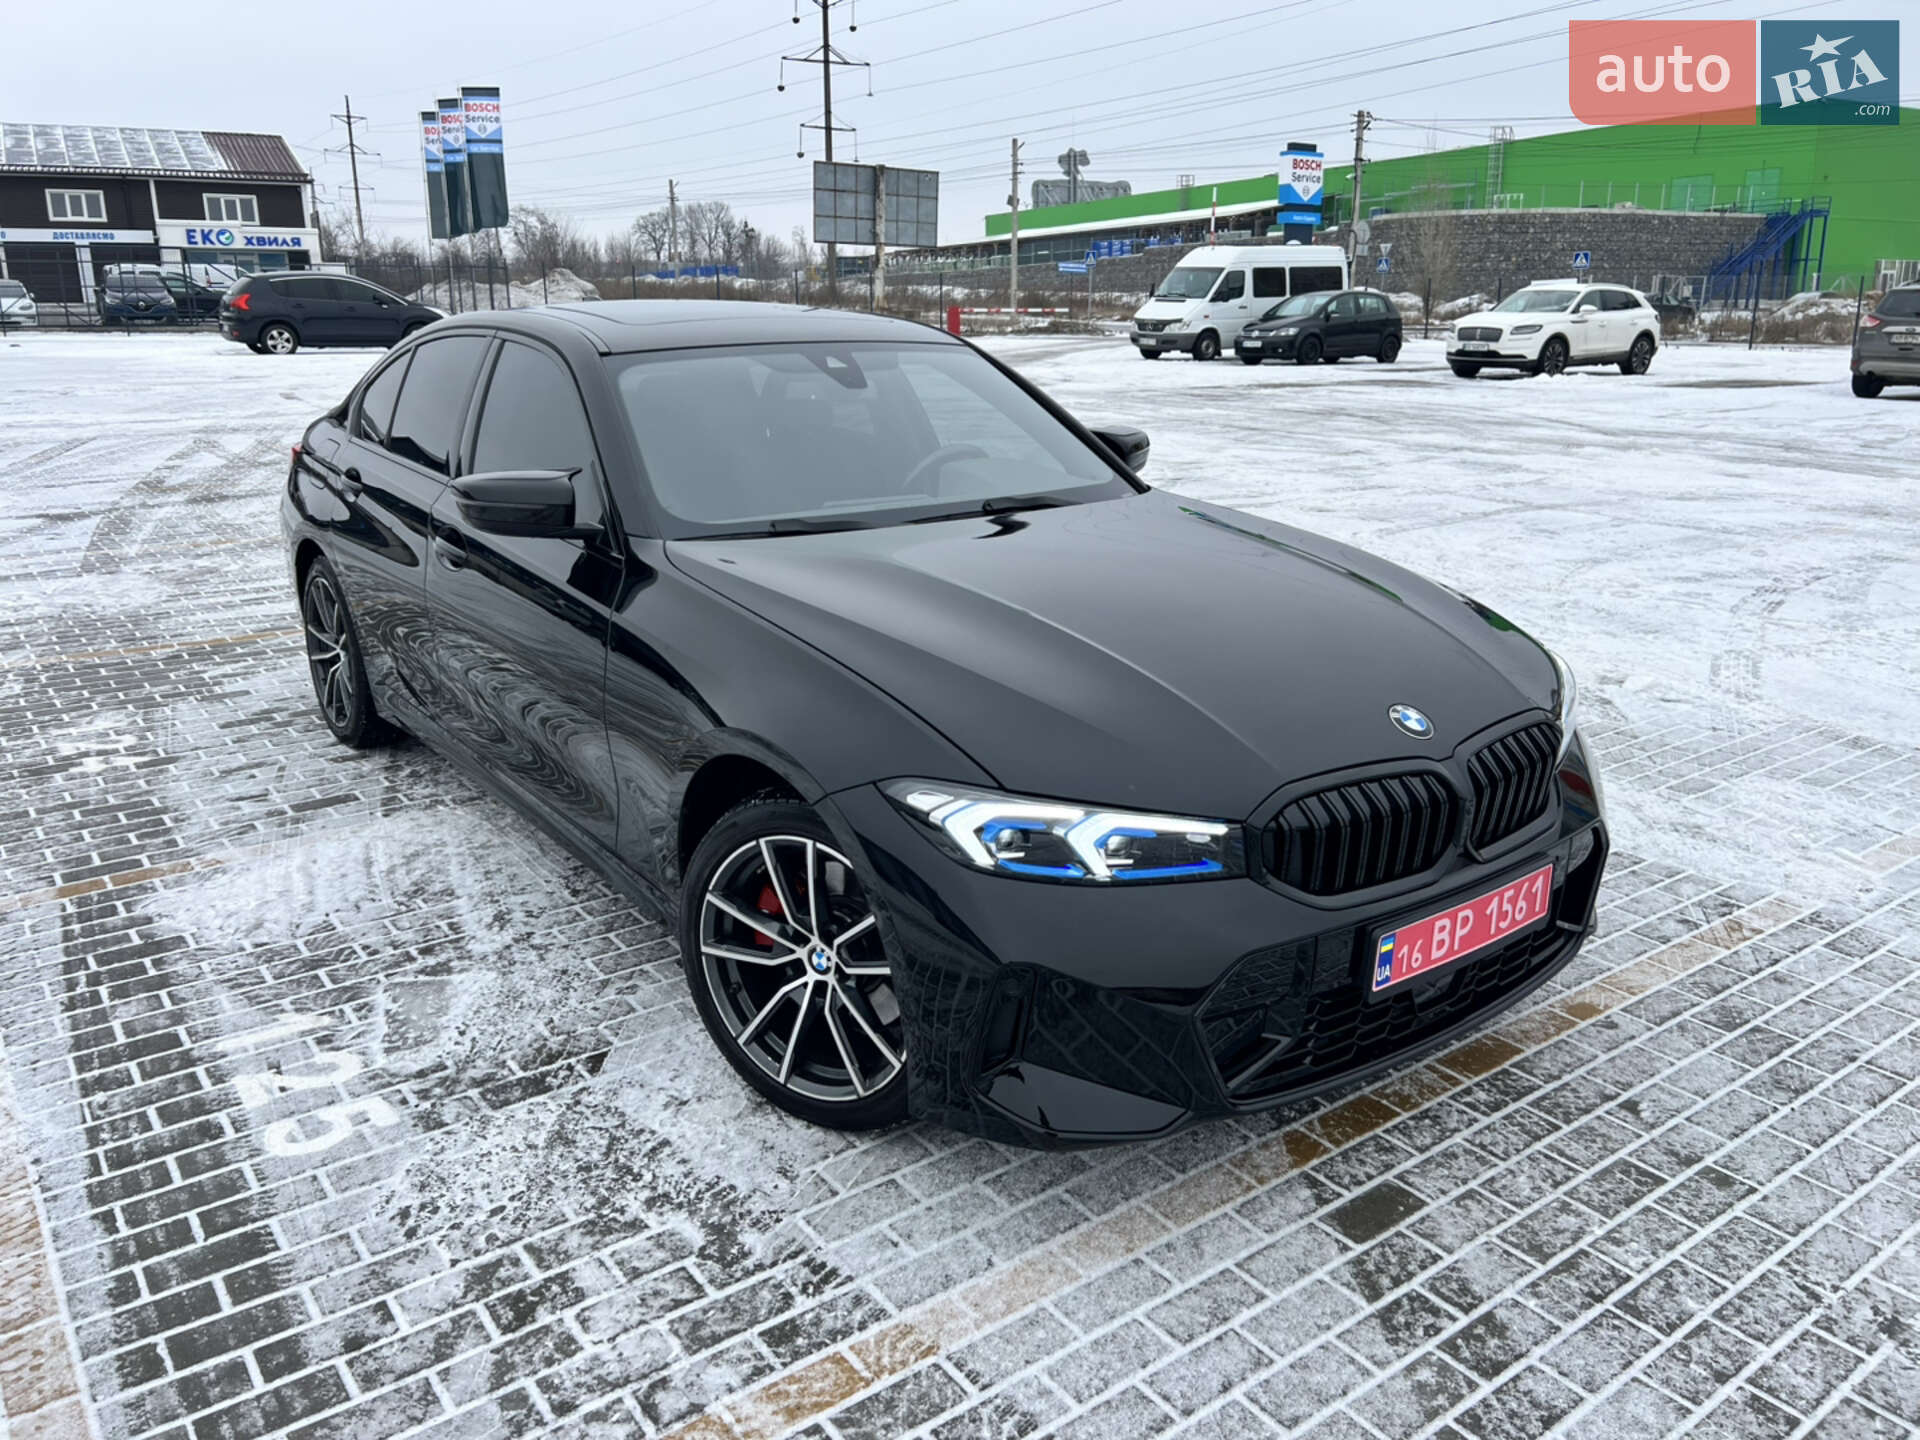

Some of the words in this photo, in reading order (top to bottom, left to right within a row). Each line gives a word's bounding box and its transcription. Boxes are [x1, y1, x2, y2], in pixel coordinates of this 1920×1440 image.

[464, 103, 500, 113] BOSCH
[464, 113, 501, 124] Service
[1292, 158, 1322, 171] BOSCH
[1291, 172, 1321, 184] Service
[243, 235, 302, 248] ХВИЛЯ
[1376, 965, 1391, 981] UA
[1397, 939, 1424, 974] 16
[1485, 874, 1545, 935] 1561
